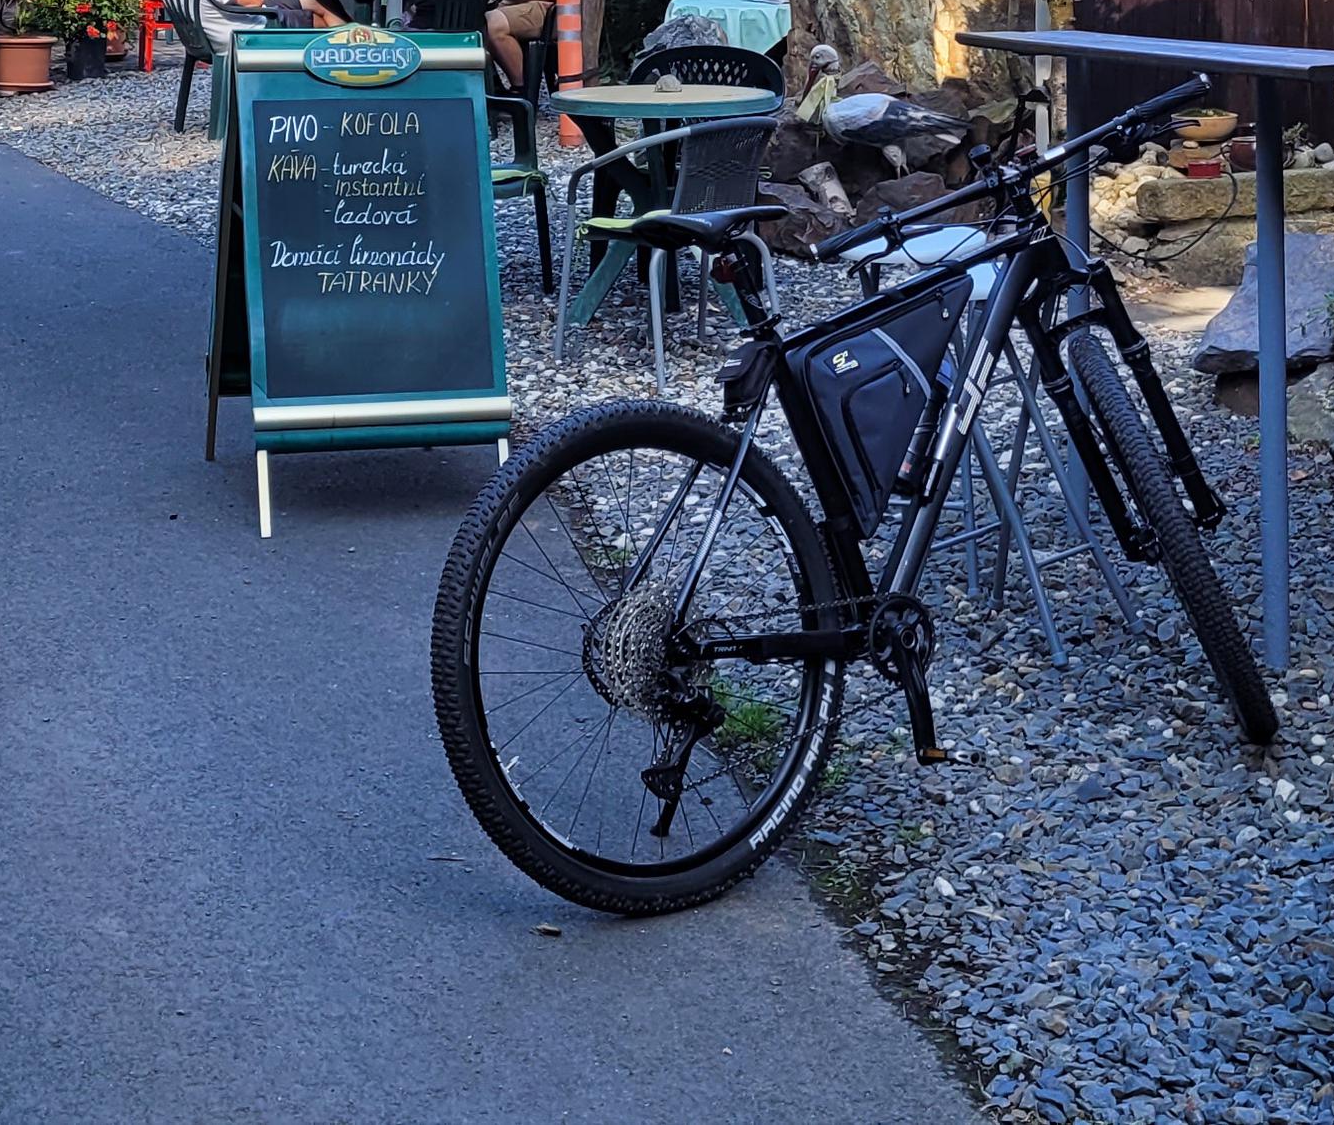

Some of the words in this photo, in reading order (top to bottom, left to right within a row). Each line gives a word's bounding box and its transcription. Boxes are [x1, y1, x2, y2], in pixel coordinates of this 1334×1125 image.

[310, 47, 415, 69] RADEGAST
[268, 114, 317, 144] PIVO
[340, 112, 419, 136] KOFOLA
[267, 149, 317, 182] KÁVA
[333, 148, 408, 176] turecká
[270, 239, 344, 268] Domácí
[349, 233, 446, 275] limonády
[317, 270, 438, 296] TATRANKY
[748, 773, 806, 851] RACING
[802, 682, 835, 772] RALPH
